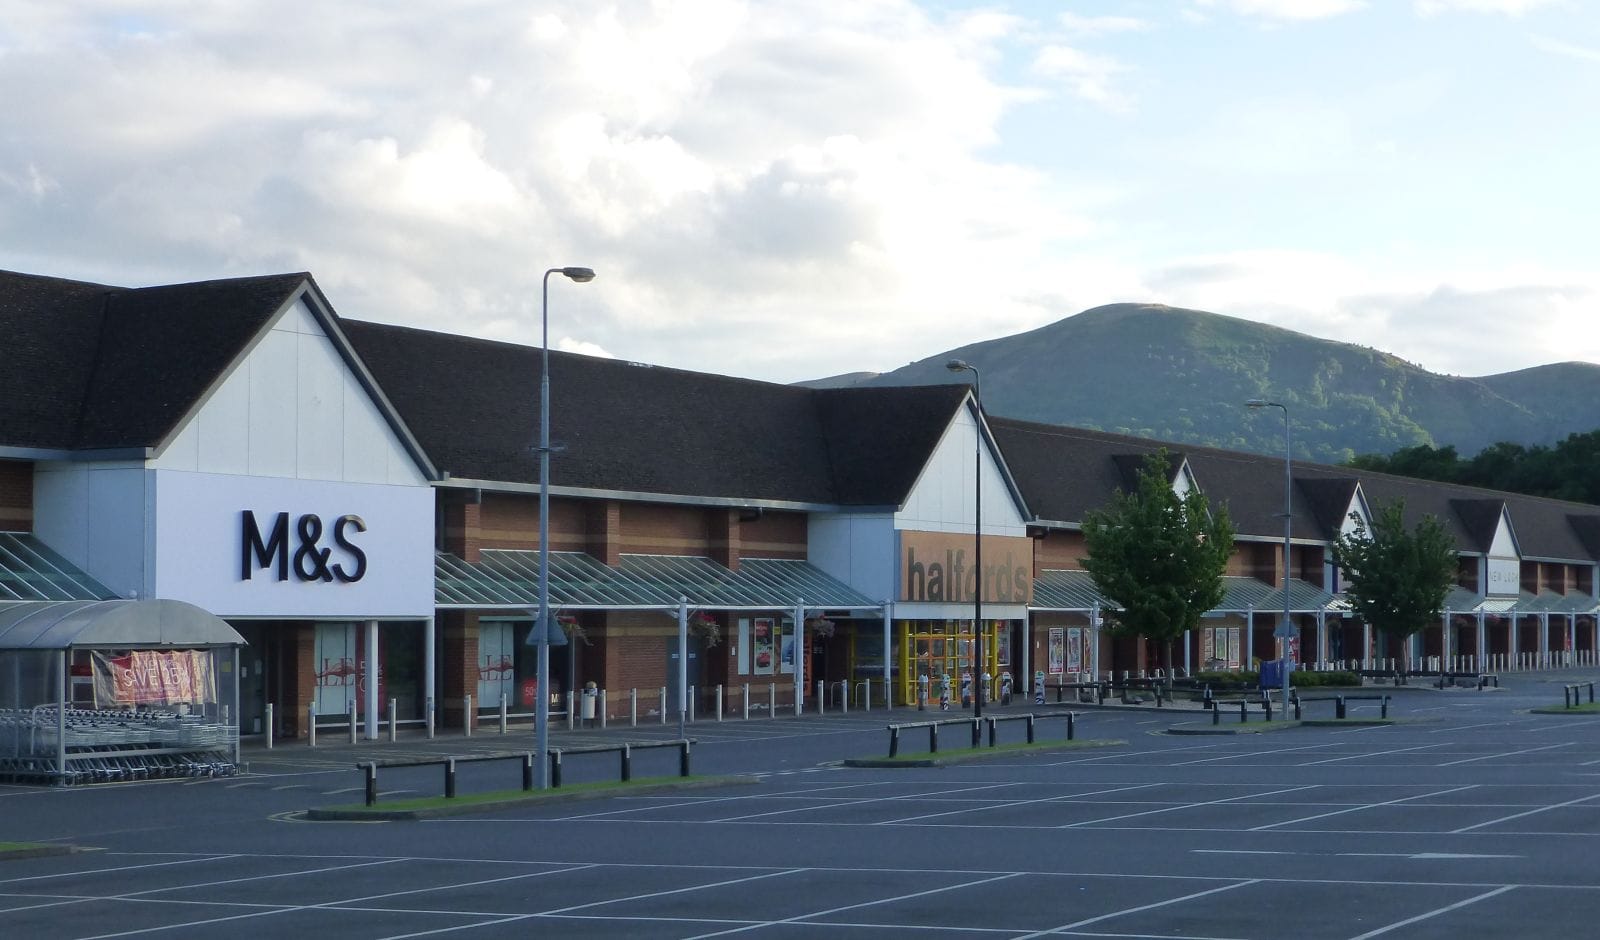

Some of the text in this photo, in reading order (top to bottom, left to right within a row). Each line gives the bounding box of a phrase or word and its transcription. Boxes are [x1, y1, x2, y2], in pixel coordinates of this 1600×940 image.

[241, 509, 367, 583] M&S
[907, 546, 1029, 602] halfords
[124, 668, 159, 688] SAVE
